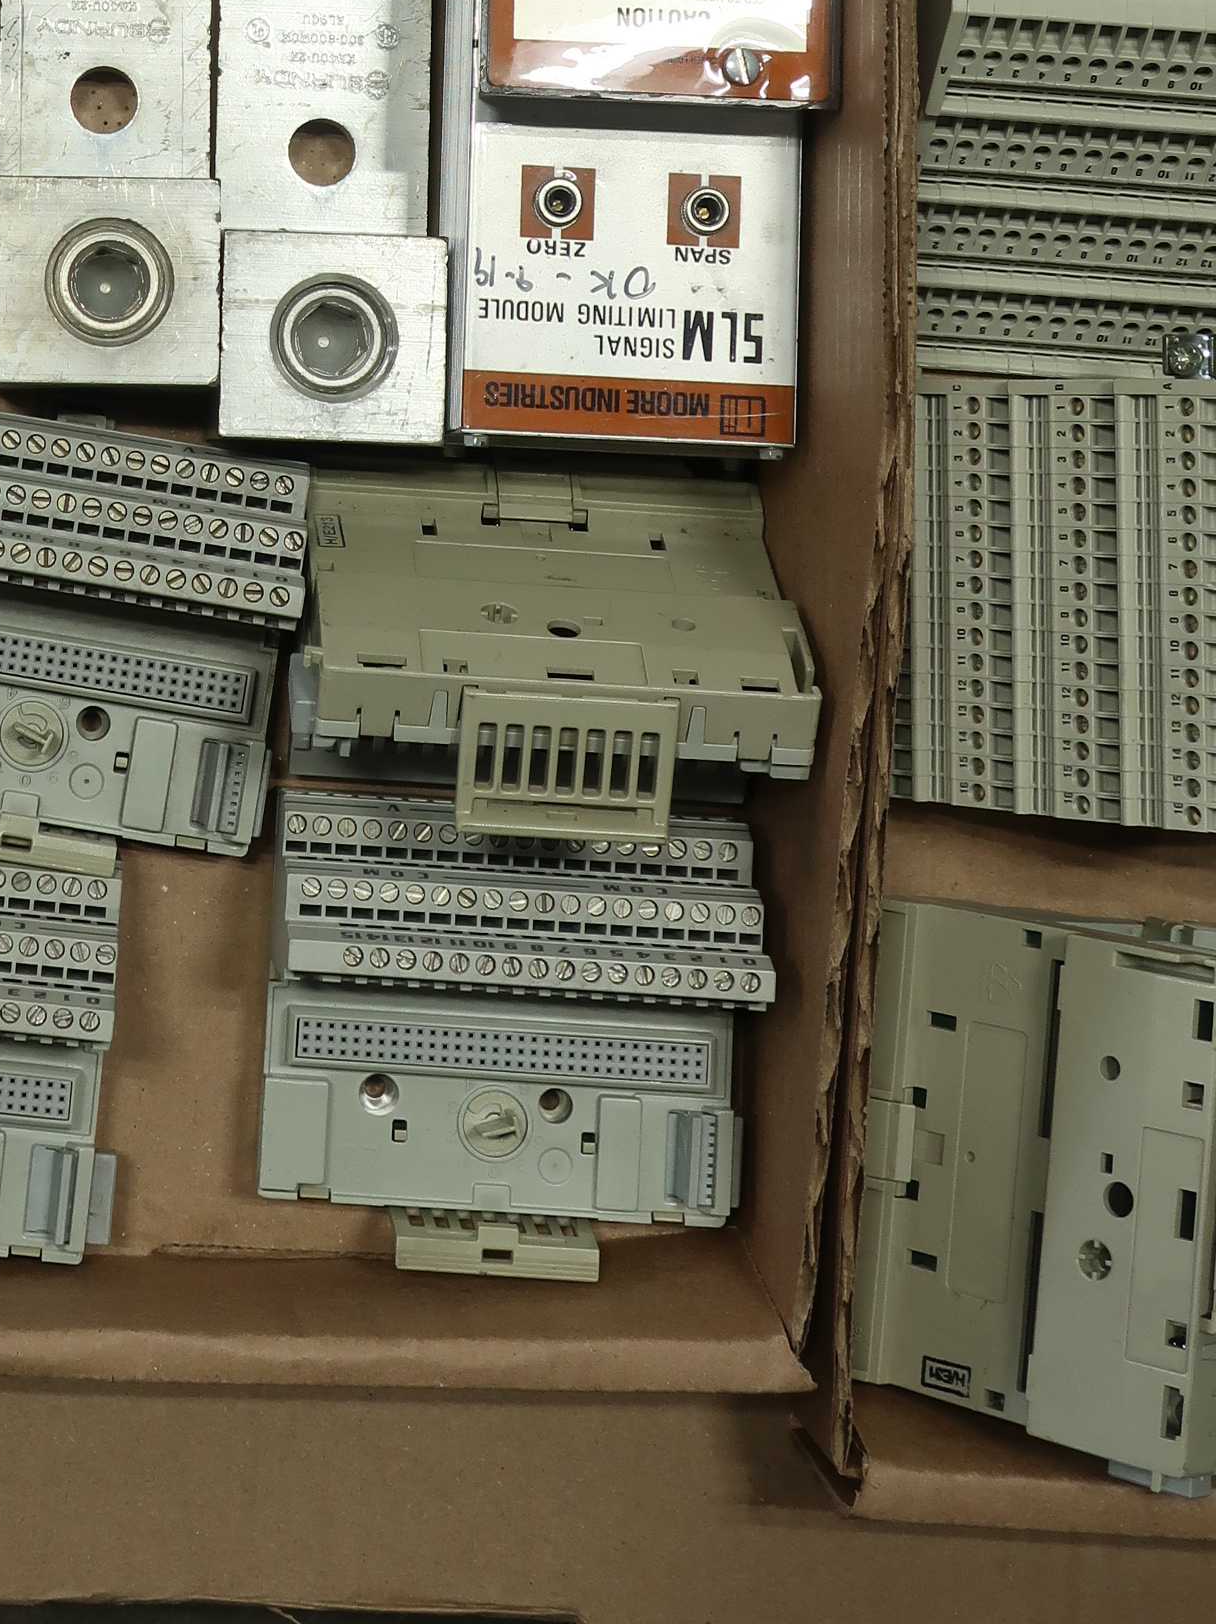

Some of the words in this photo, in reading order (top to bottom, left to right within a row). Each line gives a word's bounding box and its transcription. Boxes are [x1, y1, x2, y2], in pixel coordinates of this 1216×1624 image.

[526, 239, 586, 258] ZERO
[674, 247, 731, 266] SPAN
[589, 266, 656, 300] OK
[478, 298, 564, 323] MODULE
[576, 304, 676, 328] LIMITING
[593, 334, 675, 359] SIGNAL
[682, 309, 764, 364] SLM
[484, 381, 620, 411] INDUSTRIES
[626, 390, 709, 417] MOORE
